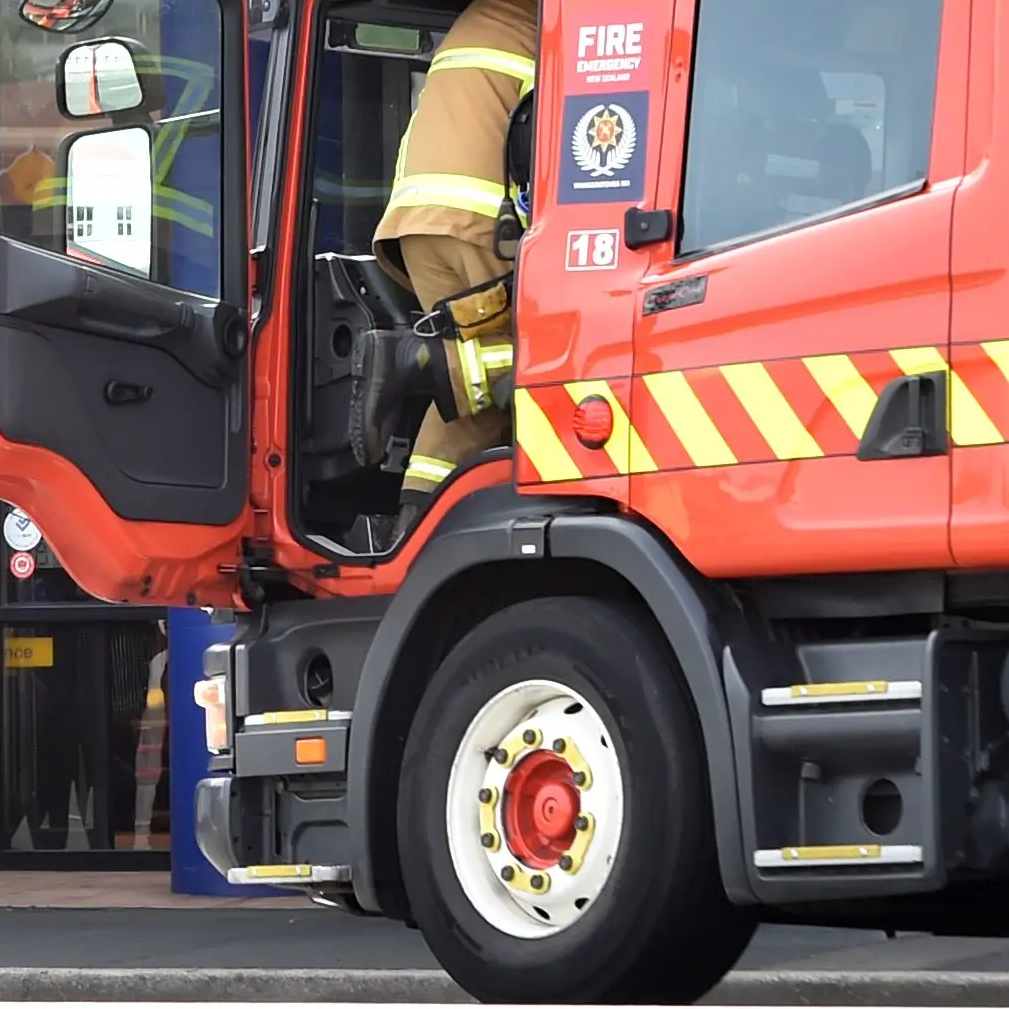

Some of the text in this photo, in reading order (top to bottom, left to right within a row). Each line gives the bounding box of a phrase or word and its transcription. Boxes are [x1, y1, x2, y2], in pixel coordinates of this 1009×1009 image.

[577, 22, 643, 58] FIRE
[576, 57, 641, 72] EMERGENCY
[571, 233, 614, 266] 18
